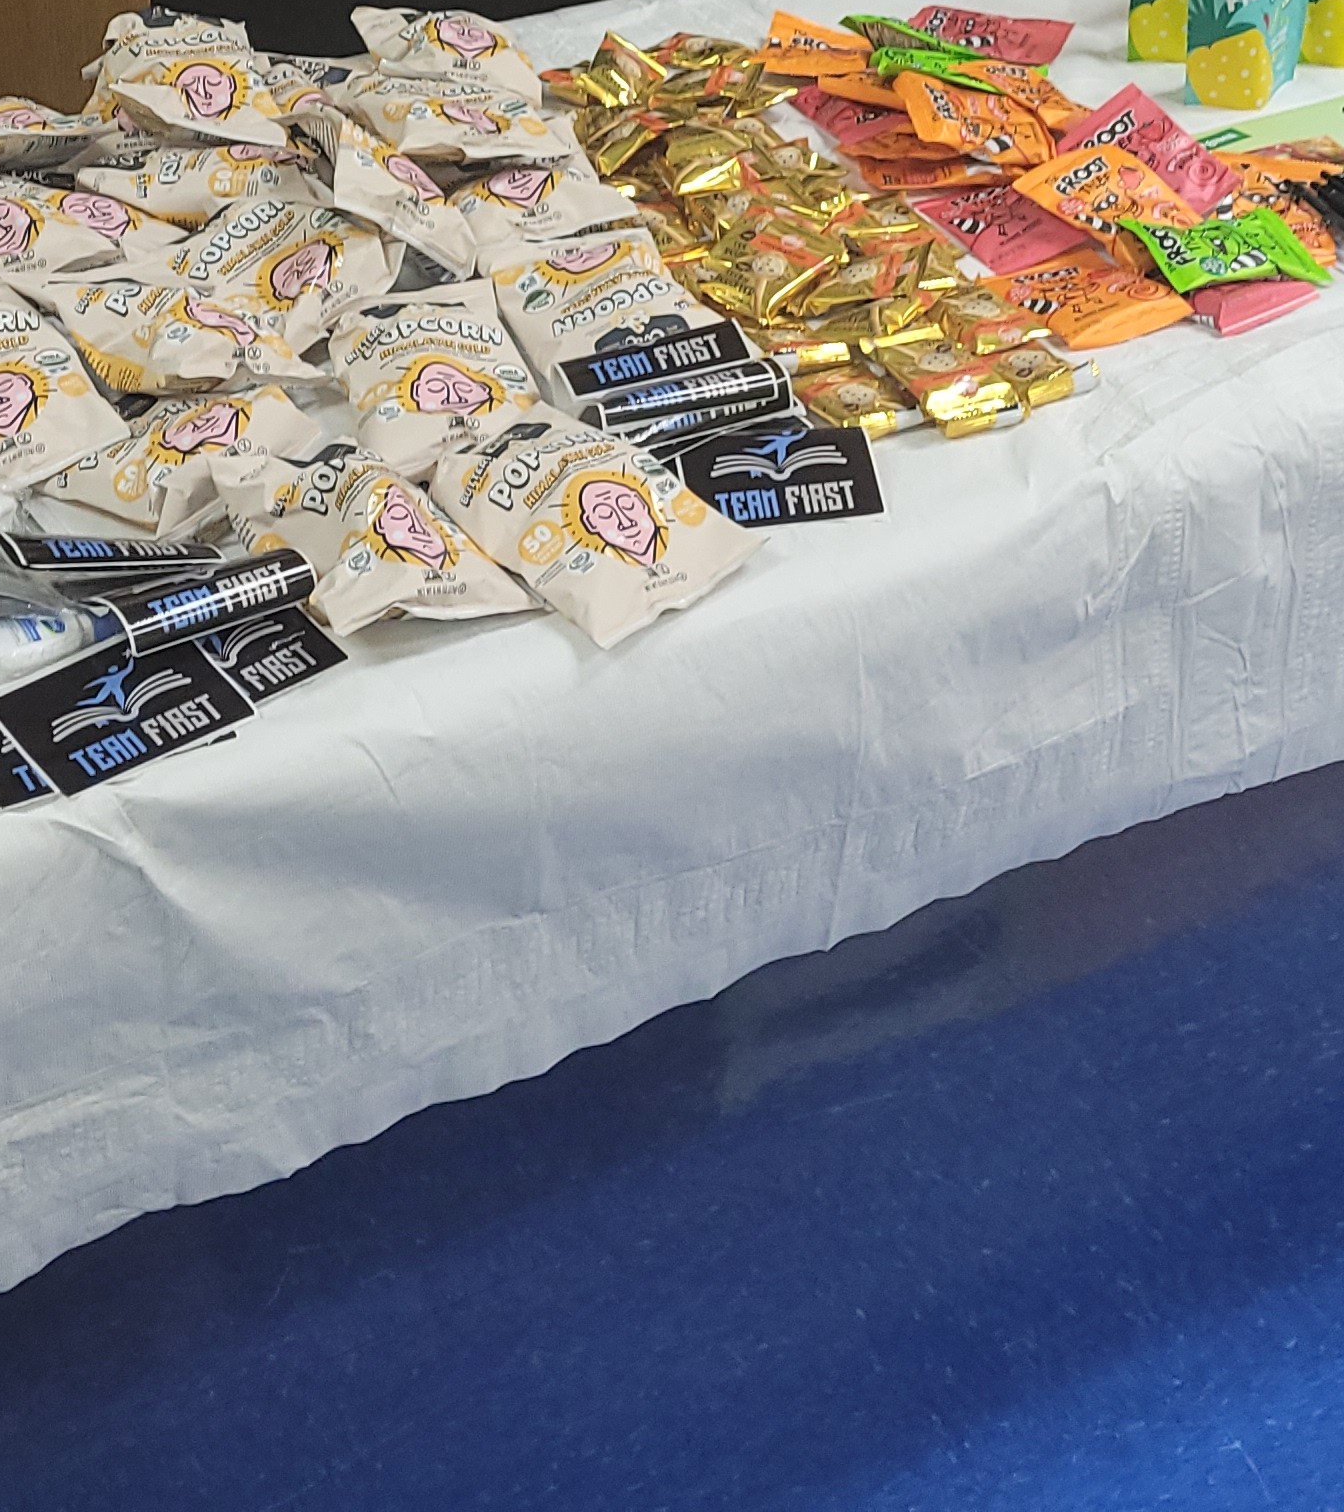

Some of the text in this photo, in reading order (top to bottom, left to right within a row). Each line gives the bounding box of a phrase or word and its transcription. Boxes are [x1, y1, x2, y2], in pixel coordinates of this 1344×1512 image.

[1083, 110, 1137, 148] ROOT
[1055, 156, 1110, 198] FROOT
[588, 332, 722, 385] TEAM FIRST
[459, 457, 494, 508] BUTTERY
[715, 480, 855, 521] TEAM FIRST
[45, 538, 114, 560] TEAM
[522, 525, 553, 555] 50
[148, 561, 291, 634] TEAM FIRST
[239, 640, 318, 692] FIRST
[68, 693, 223, 777] TEAM FIRST
